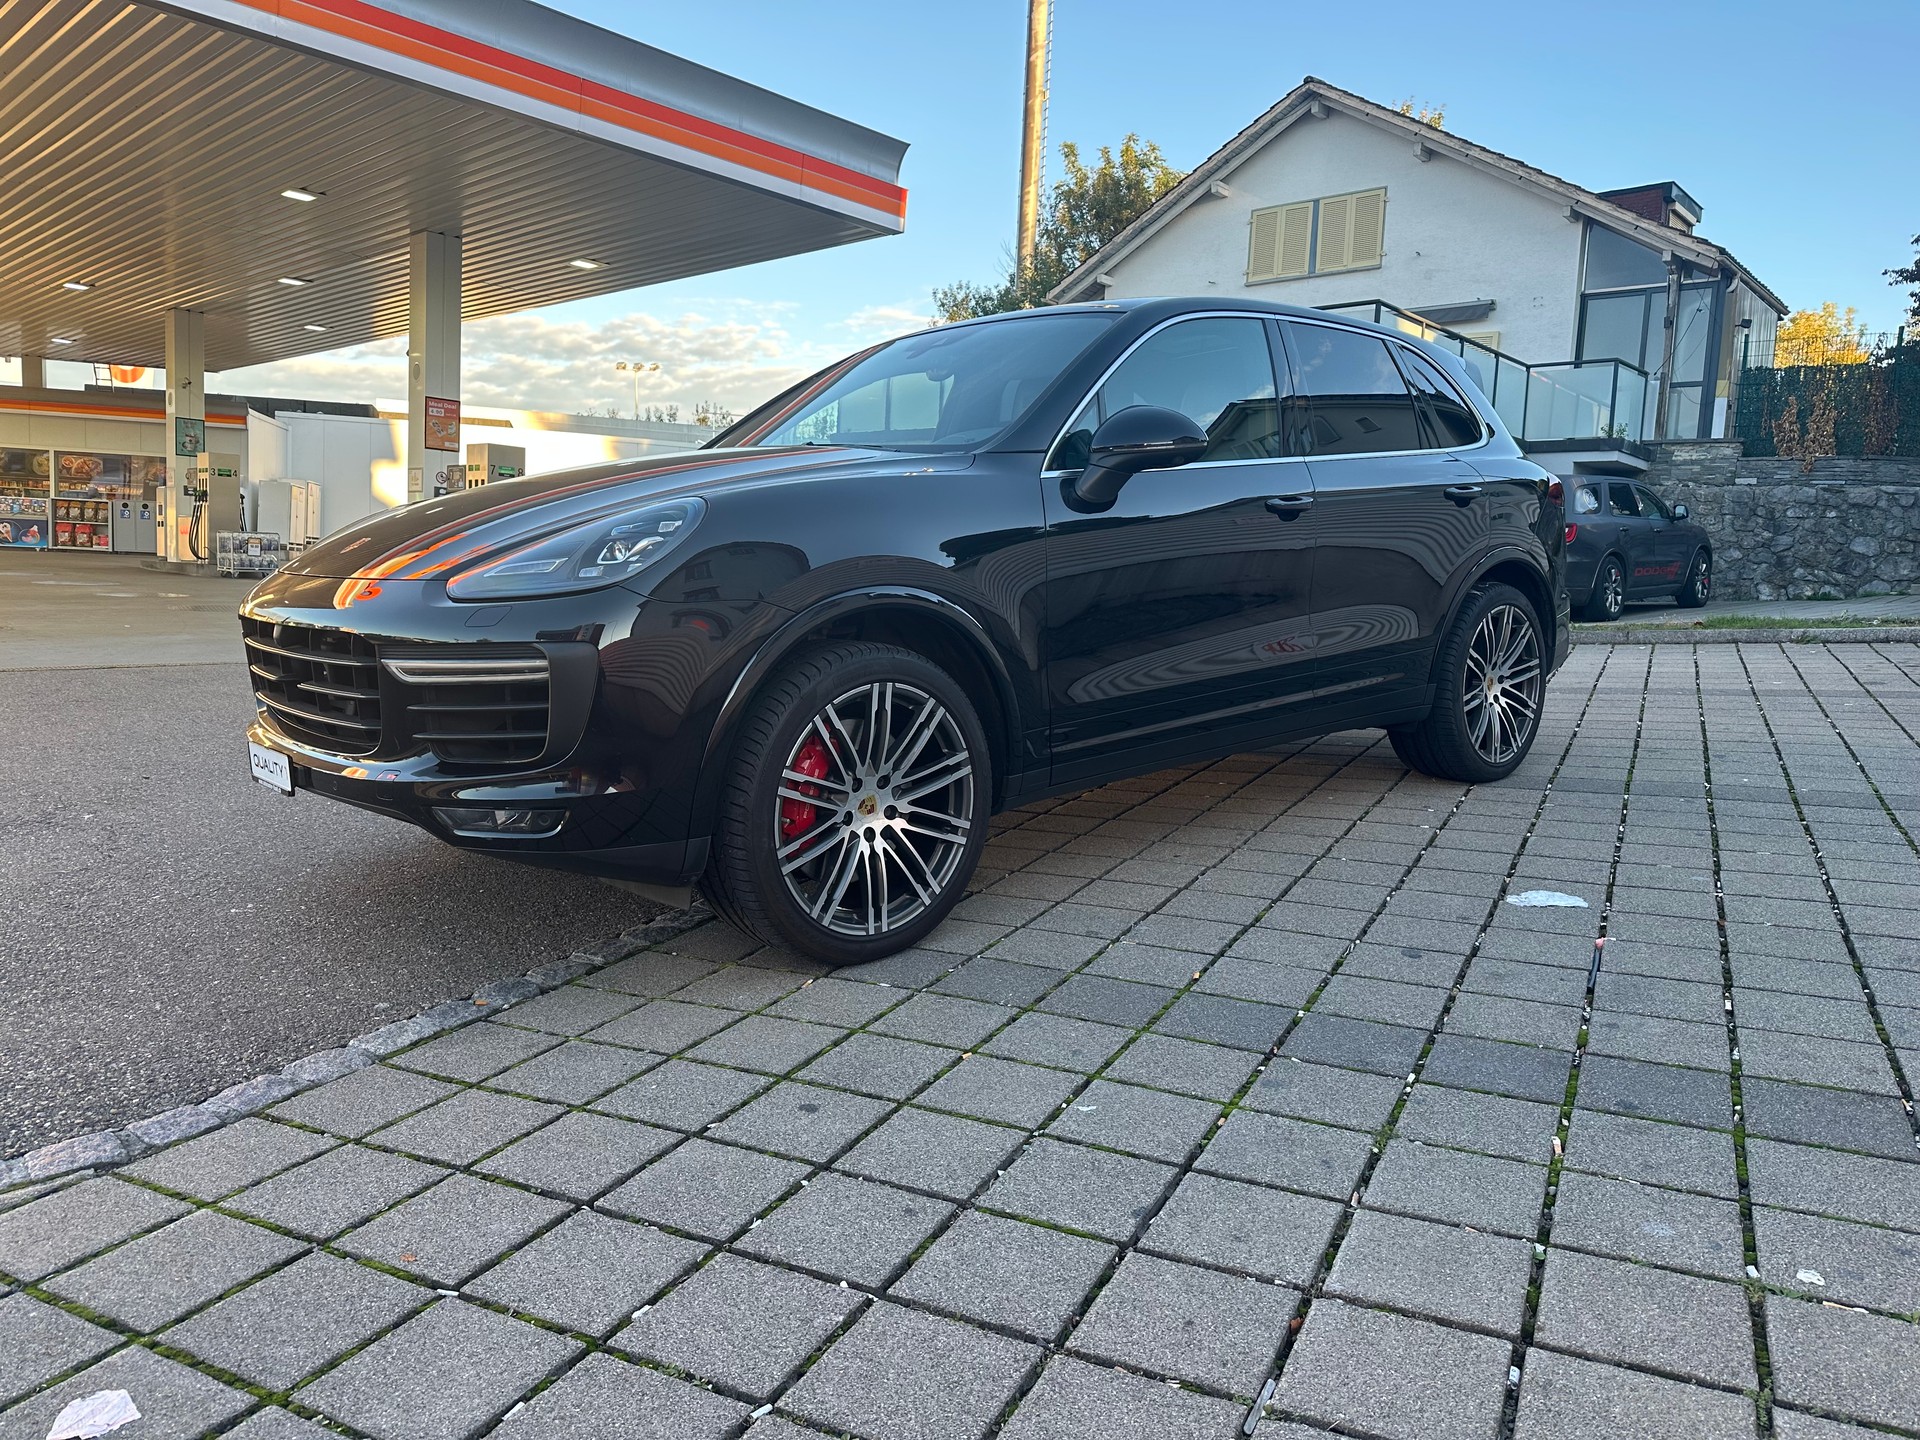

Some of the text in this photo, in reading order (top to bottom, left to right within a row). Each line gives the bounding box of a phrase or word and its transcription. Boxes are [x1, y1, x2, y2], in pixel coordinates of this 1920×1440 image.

[210, 468, 216, 476] 3
[232, 469, 238, 477] 4
[490, 464, 496, 475] 7
[517, 467, 524, 477] 8
